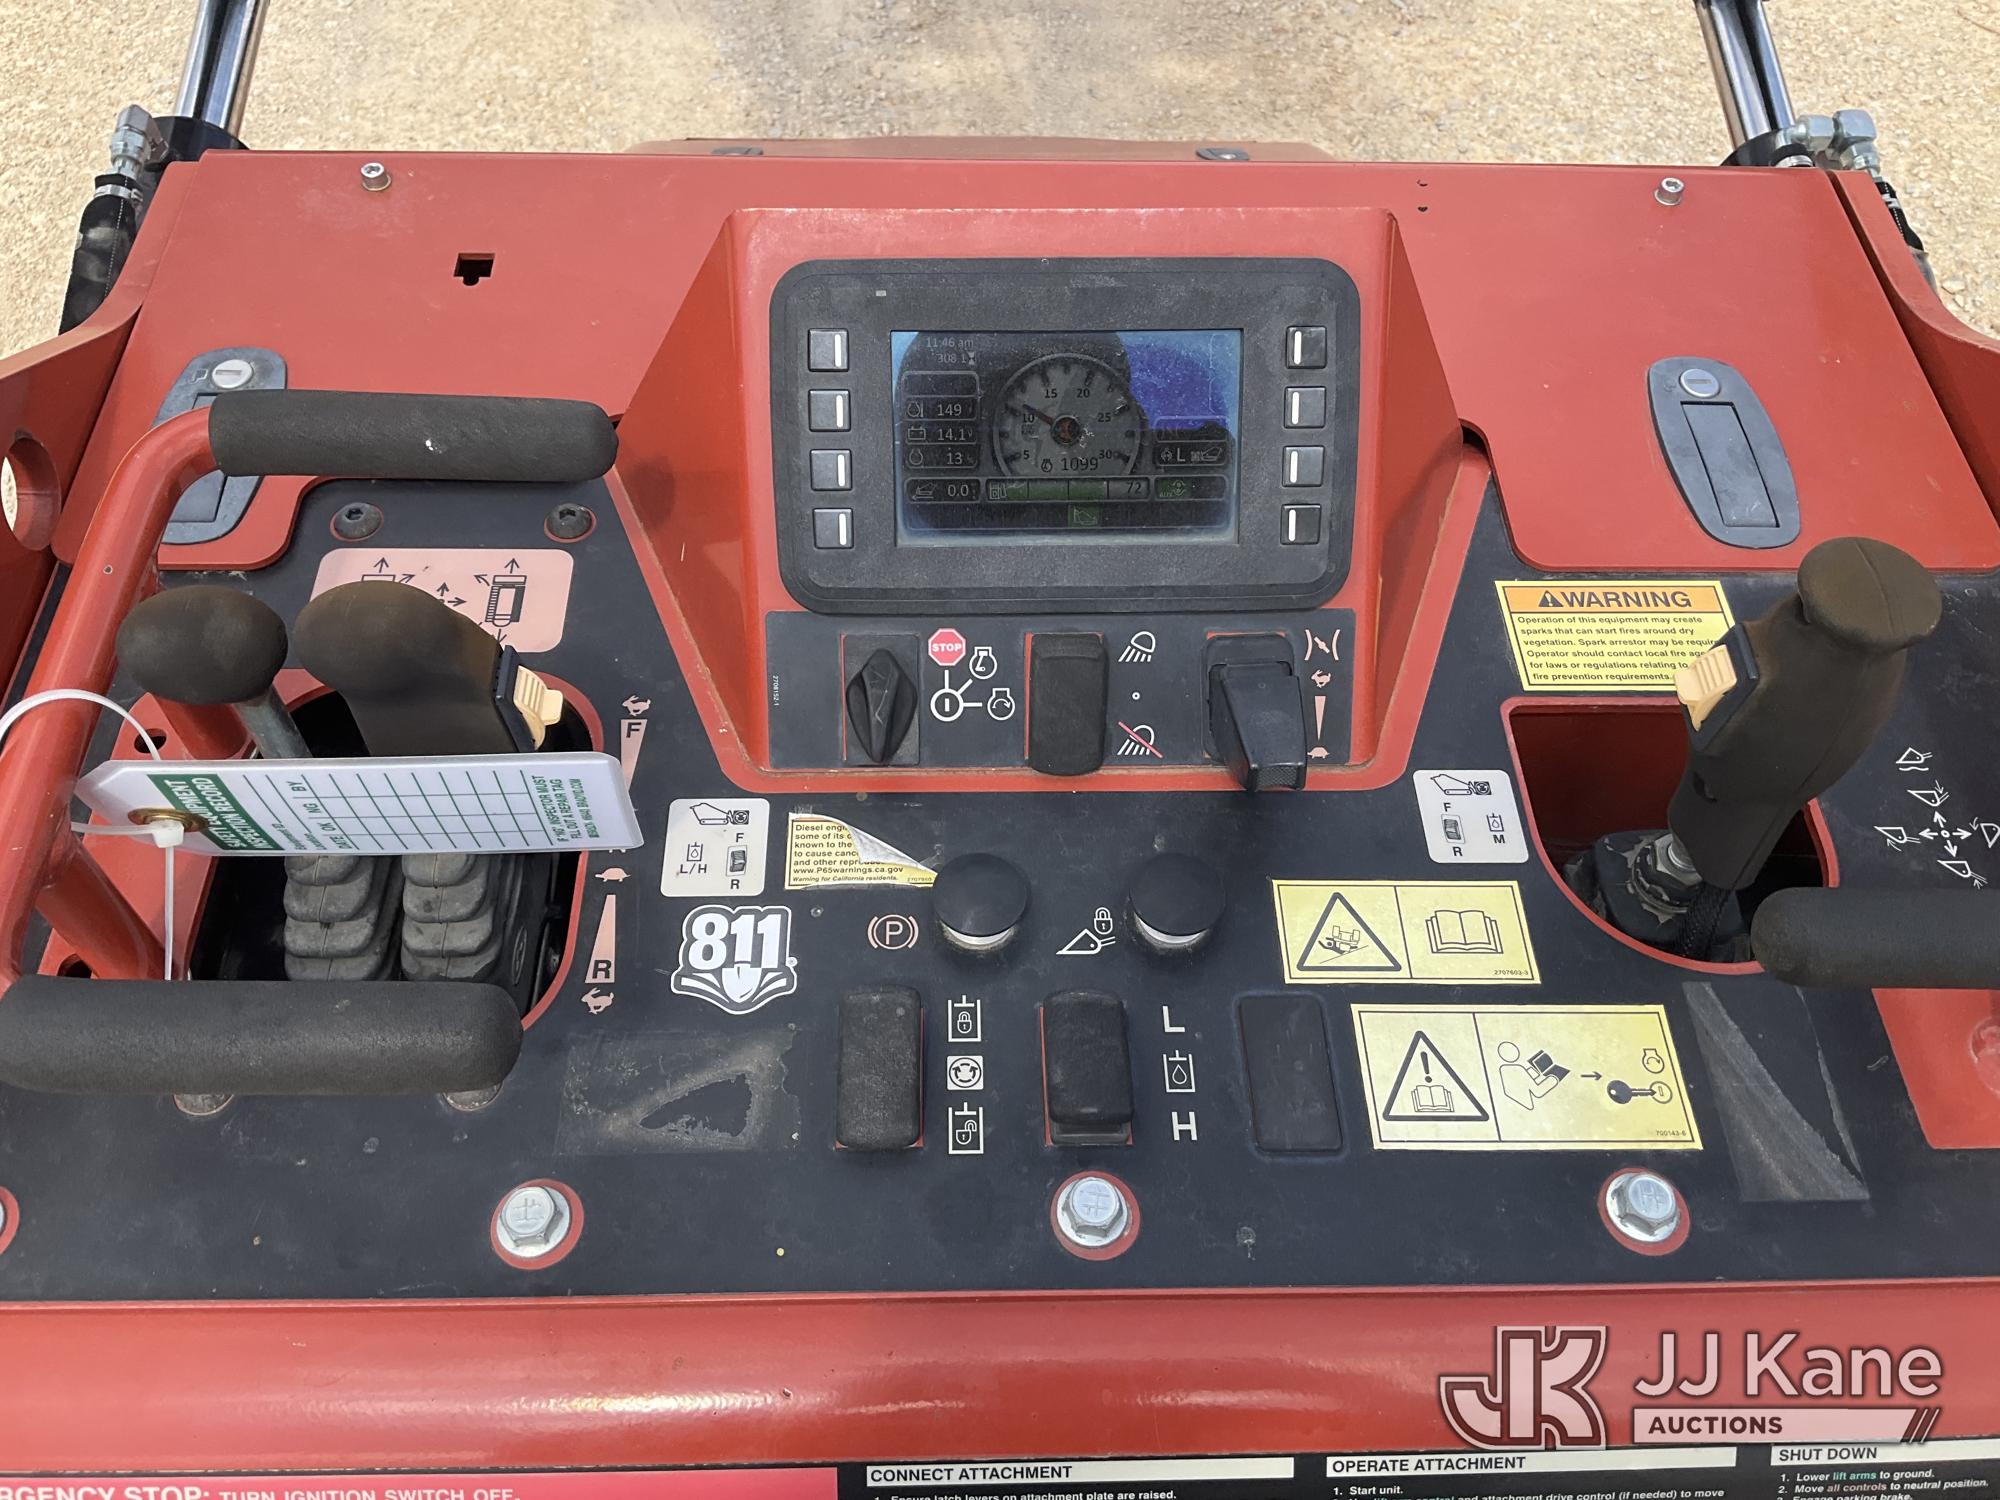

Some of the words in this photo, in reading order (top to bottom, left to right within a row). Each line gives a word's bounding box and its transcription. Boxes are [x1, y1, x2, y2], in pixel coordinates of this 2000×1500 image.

[958, 339, 975, 349] am
[1044, 389, 1058, 398] 15
[1077, 388, 1090, 398] 20
[937, 403, 962, 416] 149
[1023, 414, 1035, 423] 10
[1098, 412, 1111, 422] 25
[937, 428, 965, 441] 14.1
[946, 452, 963, 465] 13
[1023, 450, 1030, 460] 5
[1099, 450, 1112, 459] 30
[1177, 447, 1186, 462] L
[1061, 457, 1098, 471] 1099
[947, 484, 969, 497] 0.0
[1127, 482, 1142, 494] 72
[1560, 591, 1692, 607] WARNING
[1517, 616, 1564, 624] Operation
[1599, 616, 1649, 624] equipment
[1520, 627, 1553, 635] sparks
[1679, 627, 1694, 635] dry
[932, 643, 962, 652] STOP
[1523, 639, 1576, 647] vegetation.
[1578, 638, 1607, 647] Spark
[1526, 650, 1569, 658] Operator
[1583, 662, 1637, 670] regulations
[1640, 662, 1677, 670] relating
[1551, 673, 1603, 681] prevention
[1605, 673, 1673, 681] requirements.
[626, 722, 642, 738] F
[286, 780, 307, 792] BY
[532, 775, 549, 793] MUST
[550, 779, 565, 793] TAG
[192, 778, 237, 812] RECORD
[303, 803, 321, 813] NG
[554, 793, 573, 814] REPAIR
[1443, 802, 1452, 812] F
[538, 794, 562, 825] INSPECTOR
[317, 822, 336, 831] OK
[563, 819, 578, 830] OUT
[220, 813, 274, 849] INSPECTION
[736, 833, 744, 842] F
[1493, 834, 1506, 844] M
[1452, 846, 1463, 856] R
[793, 867, 904, 876] www.P65warnings.ca.gov
[730, 880, 740, 889] R
[885, 920, 904, 944] P
[688, 912, 782, 970] 811
[592, 959, 612, 979] R
[1162, 1005, 1186, 1033] L
[1171, 1111, 1198, 1141] H
[1779, 1448, 1823, 1461] SHUT
[1827, 1447, 1877, 1460] DOWN
[1332, 1458, 1409, 1473] OPERATE
[1414, 1456, 1527, 1472] ATTACHMENT
[871, 1467, 954, 1482] CONNECT
[958, 1465, 1073, 1481] ATTACHMENT
[1780, 1473, 1790, 1482] 1.
[1796, 1473, 1830, 1482] Lower
[1832, 1472, 1847, 1480] lift
[1849, 1472, 1877, 1480] arms
[1879, 1470, 1890, 1479] to
[1893, 1469, 1935, 1480] ground.
[1333, 1486, 1343, 1495] 1.
[1349, 1486, 1376, 1495] Start
[1379, 1485, 1403, 1495] unit.
[1777, 1485, 1788, 1494] 2.
[1794, 1484, 1825, 1493] Move
[1827, 1483, 1841, 1492] all
[1842, 1482, 1888, 1492] controls
[1890, 1482, 1901, 1490] to
[1903, 1480, 1941, 1490] neutral
[1943, 1478, 1989, 1490] position.
[219, 1491, 275, 1500] TURN
[284, 1490, 376, 1500] IGNITION
[384, 1489, 465, 1500] SWITCH
[473, 1489, 521, 1500] OFF.
[1020, 1492, 1083, 1500] attachment
[1086, 1490, 1114, 1500] plate
[1117, 1491, 1136, 1500] are
[1138, 1489, 1177, 1500] raised.
[1576, 1492, 1616, 1500] control
[1617, 1490, 1630, 1500] (if
[1632, 1490, 1677, 1500] needed)
[1680, 1490, 1692, 1499] to
[1694, 1489, 1725, 1498] move
